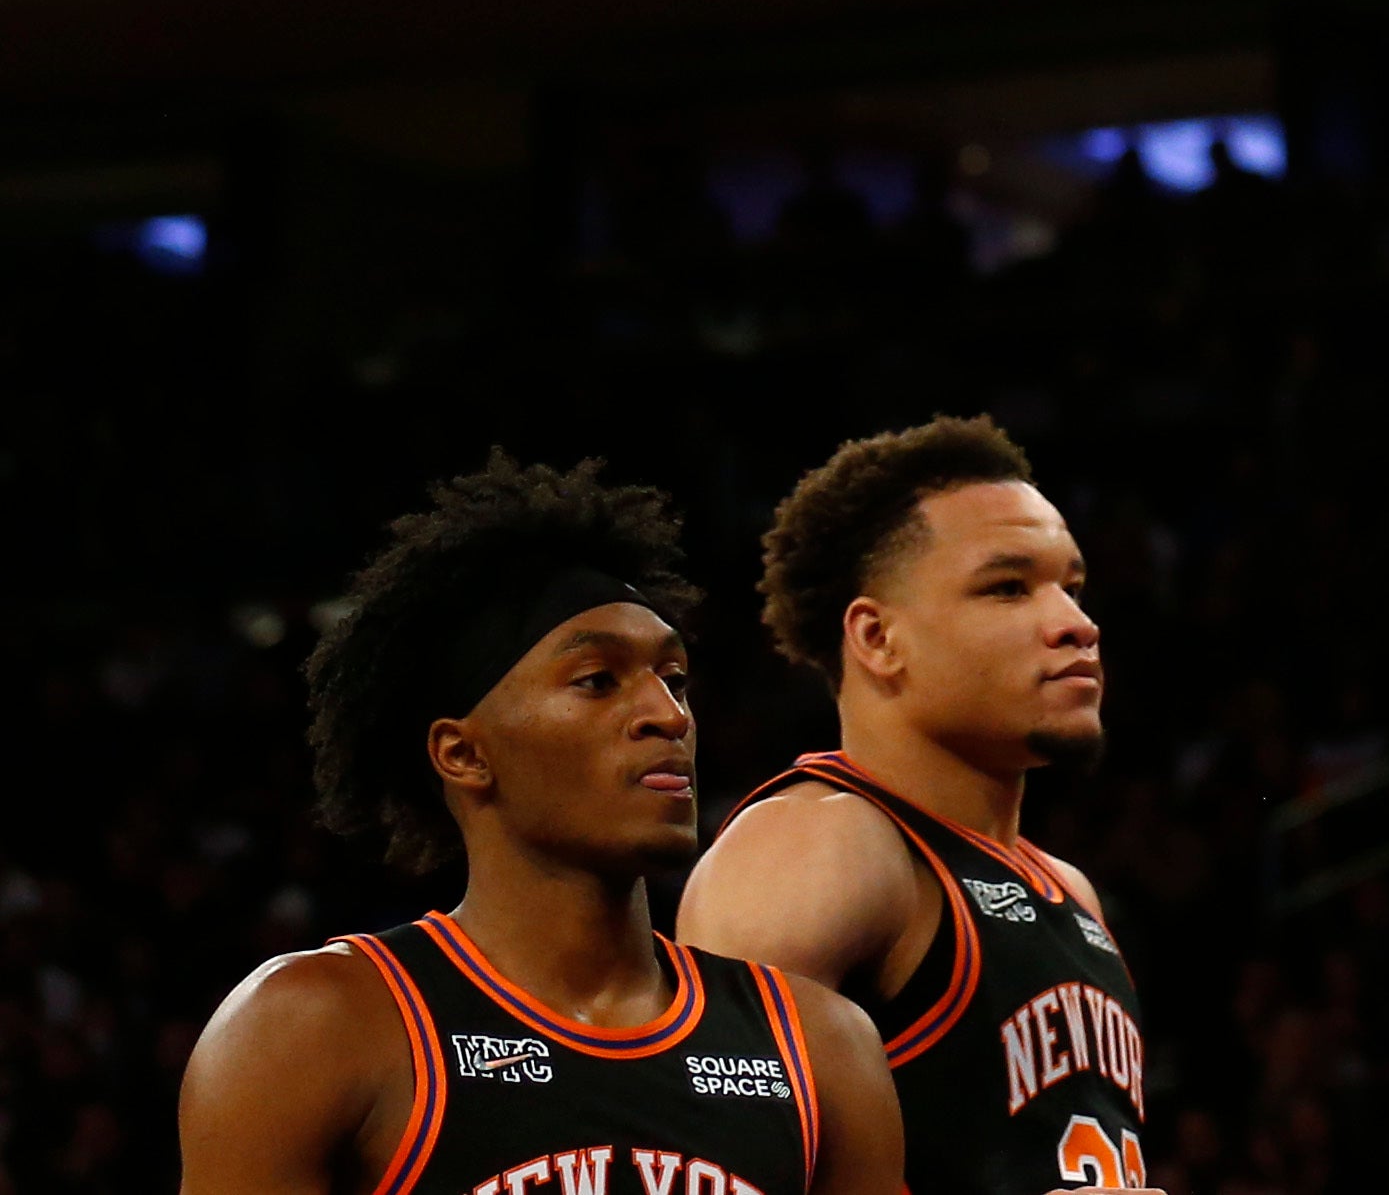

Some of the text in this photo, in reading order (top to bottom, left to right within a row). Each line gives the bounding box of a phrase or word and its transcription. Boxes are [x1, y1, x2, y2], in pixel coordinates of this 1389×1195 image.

[451, 1034, 553, 1083] NYC
[685, 1056, 783, 1079] SQUARE
[1000, 981, 1091, 1119] NEW
[692, 1076, 772, 1098] SPACE
